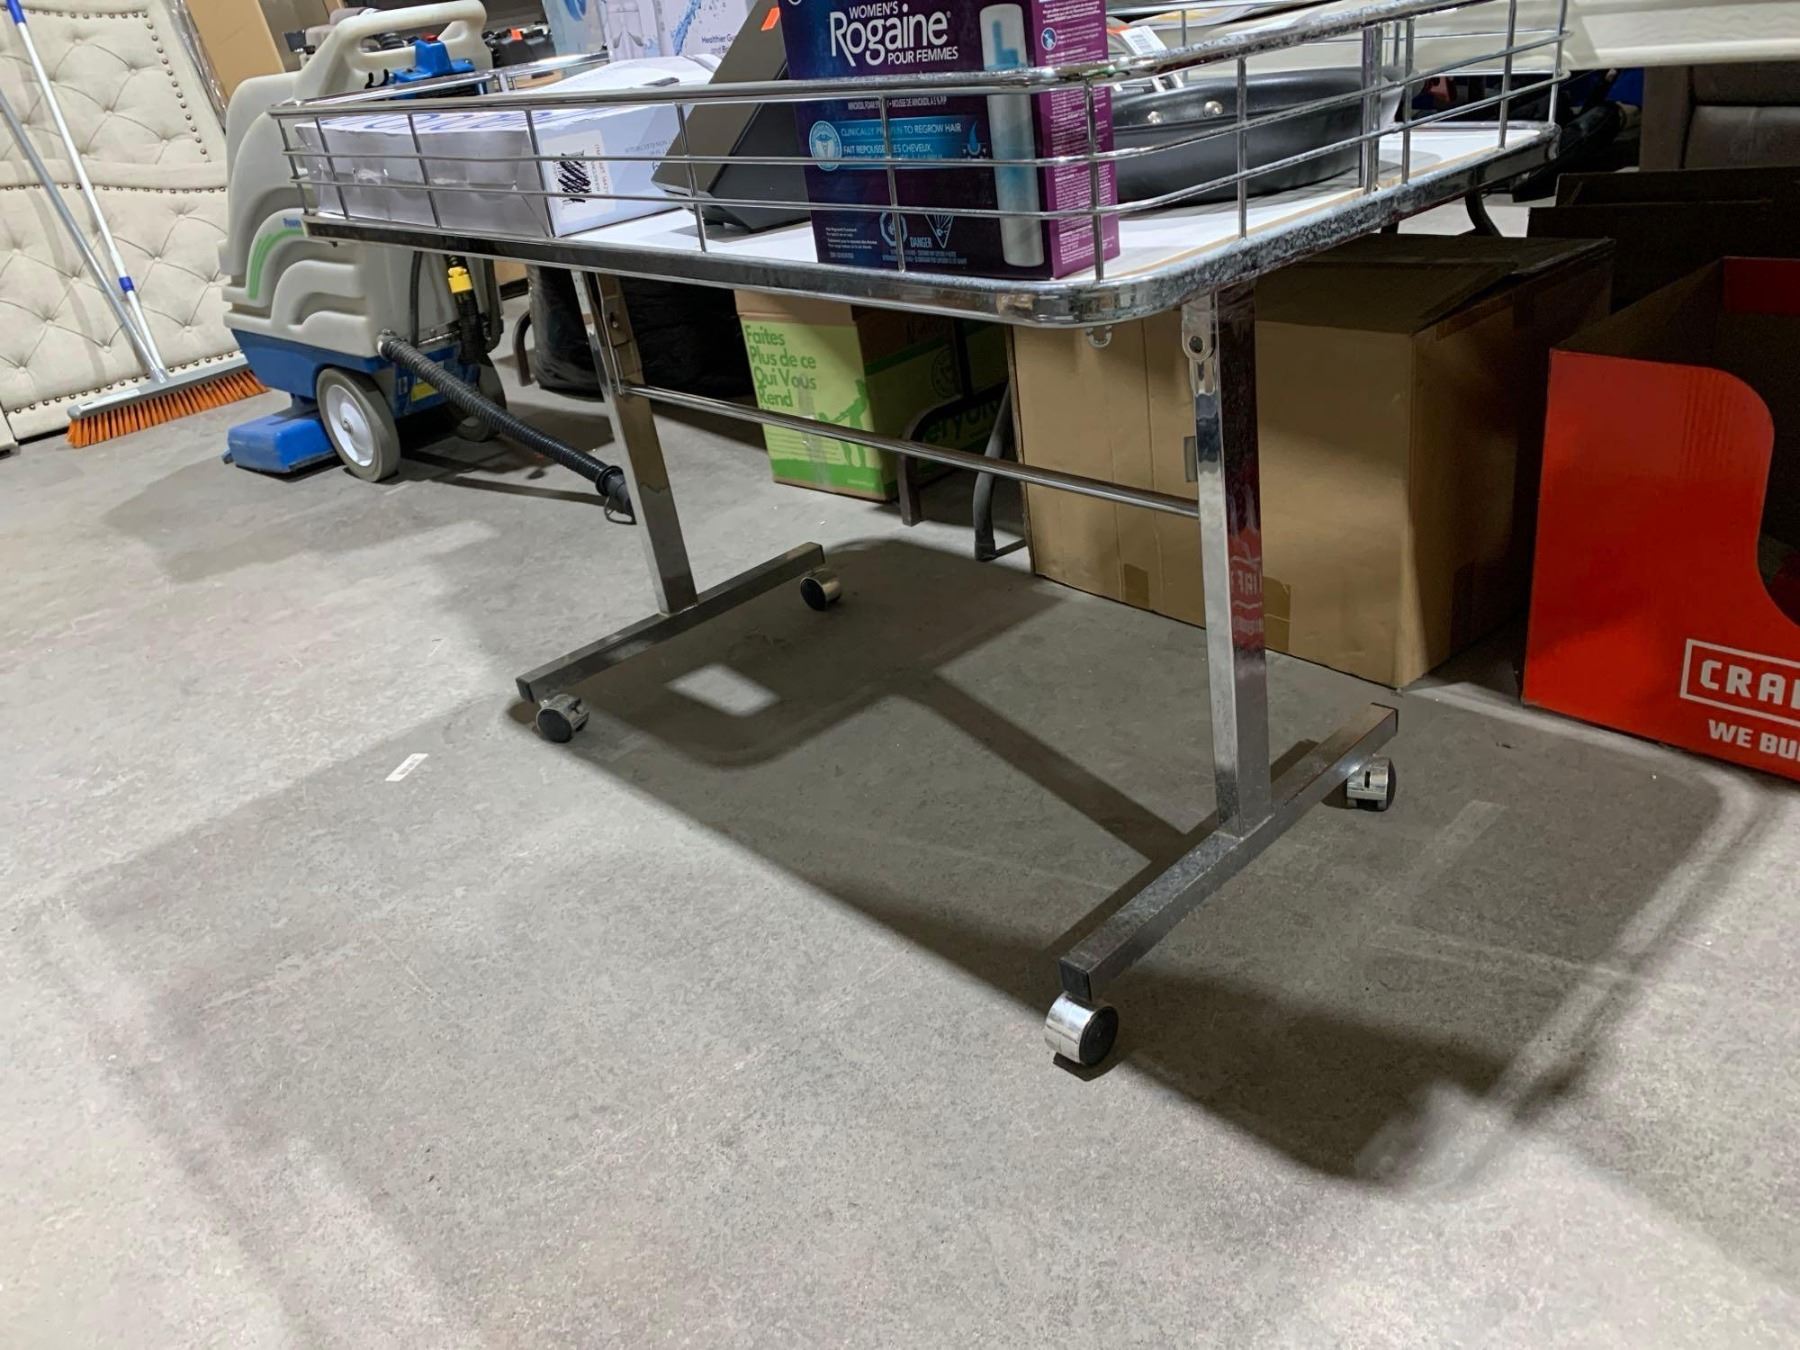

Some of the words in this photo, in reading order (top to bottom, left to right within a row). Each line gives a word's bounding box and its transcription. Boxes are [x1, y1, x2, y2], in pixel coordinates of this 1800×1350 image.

[849, 1, 898, 19] WOMEN'S
[829, 3, 949, 67] Rogaine
[888, 50, 914, 65] POUR
[916, 46, 959, 62] FEMMES
[904, 124, 914, 134] TO
[914, 123, 944, 134] REGROW
[945, 121, 961, 132] HAIR
[856, 144, 886, 154] REPOUSSE
[745, 325, 785, 346] Faites
[750, 345, 777, 366] Plus
[780, 348, 798, 368] de
[801, 356, 817, 369] ce
[754, 366, 778, 389] Qui
[778, 368, 817, 390] Vous
[758, 386, 794, 407] Rend
[1709, 719, 1753, 748] WE
